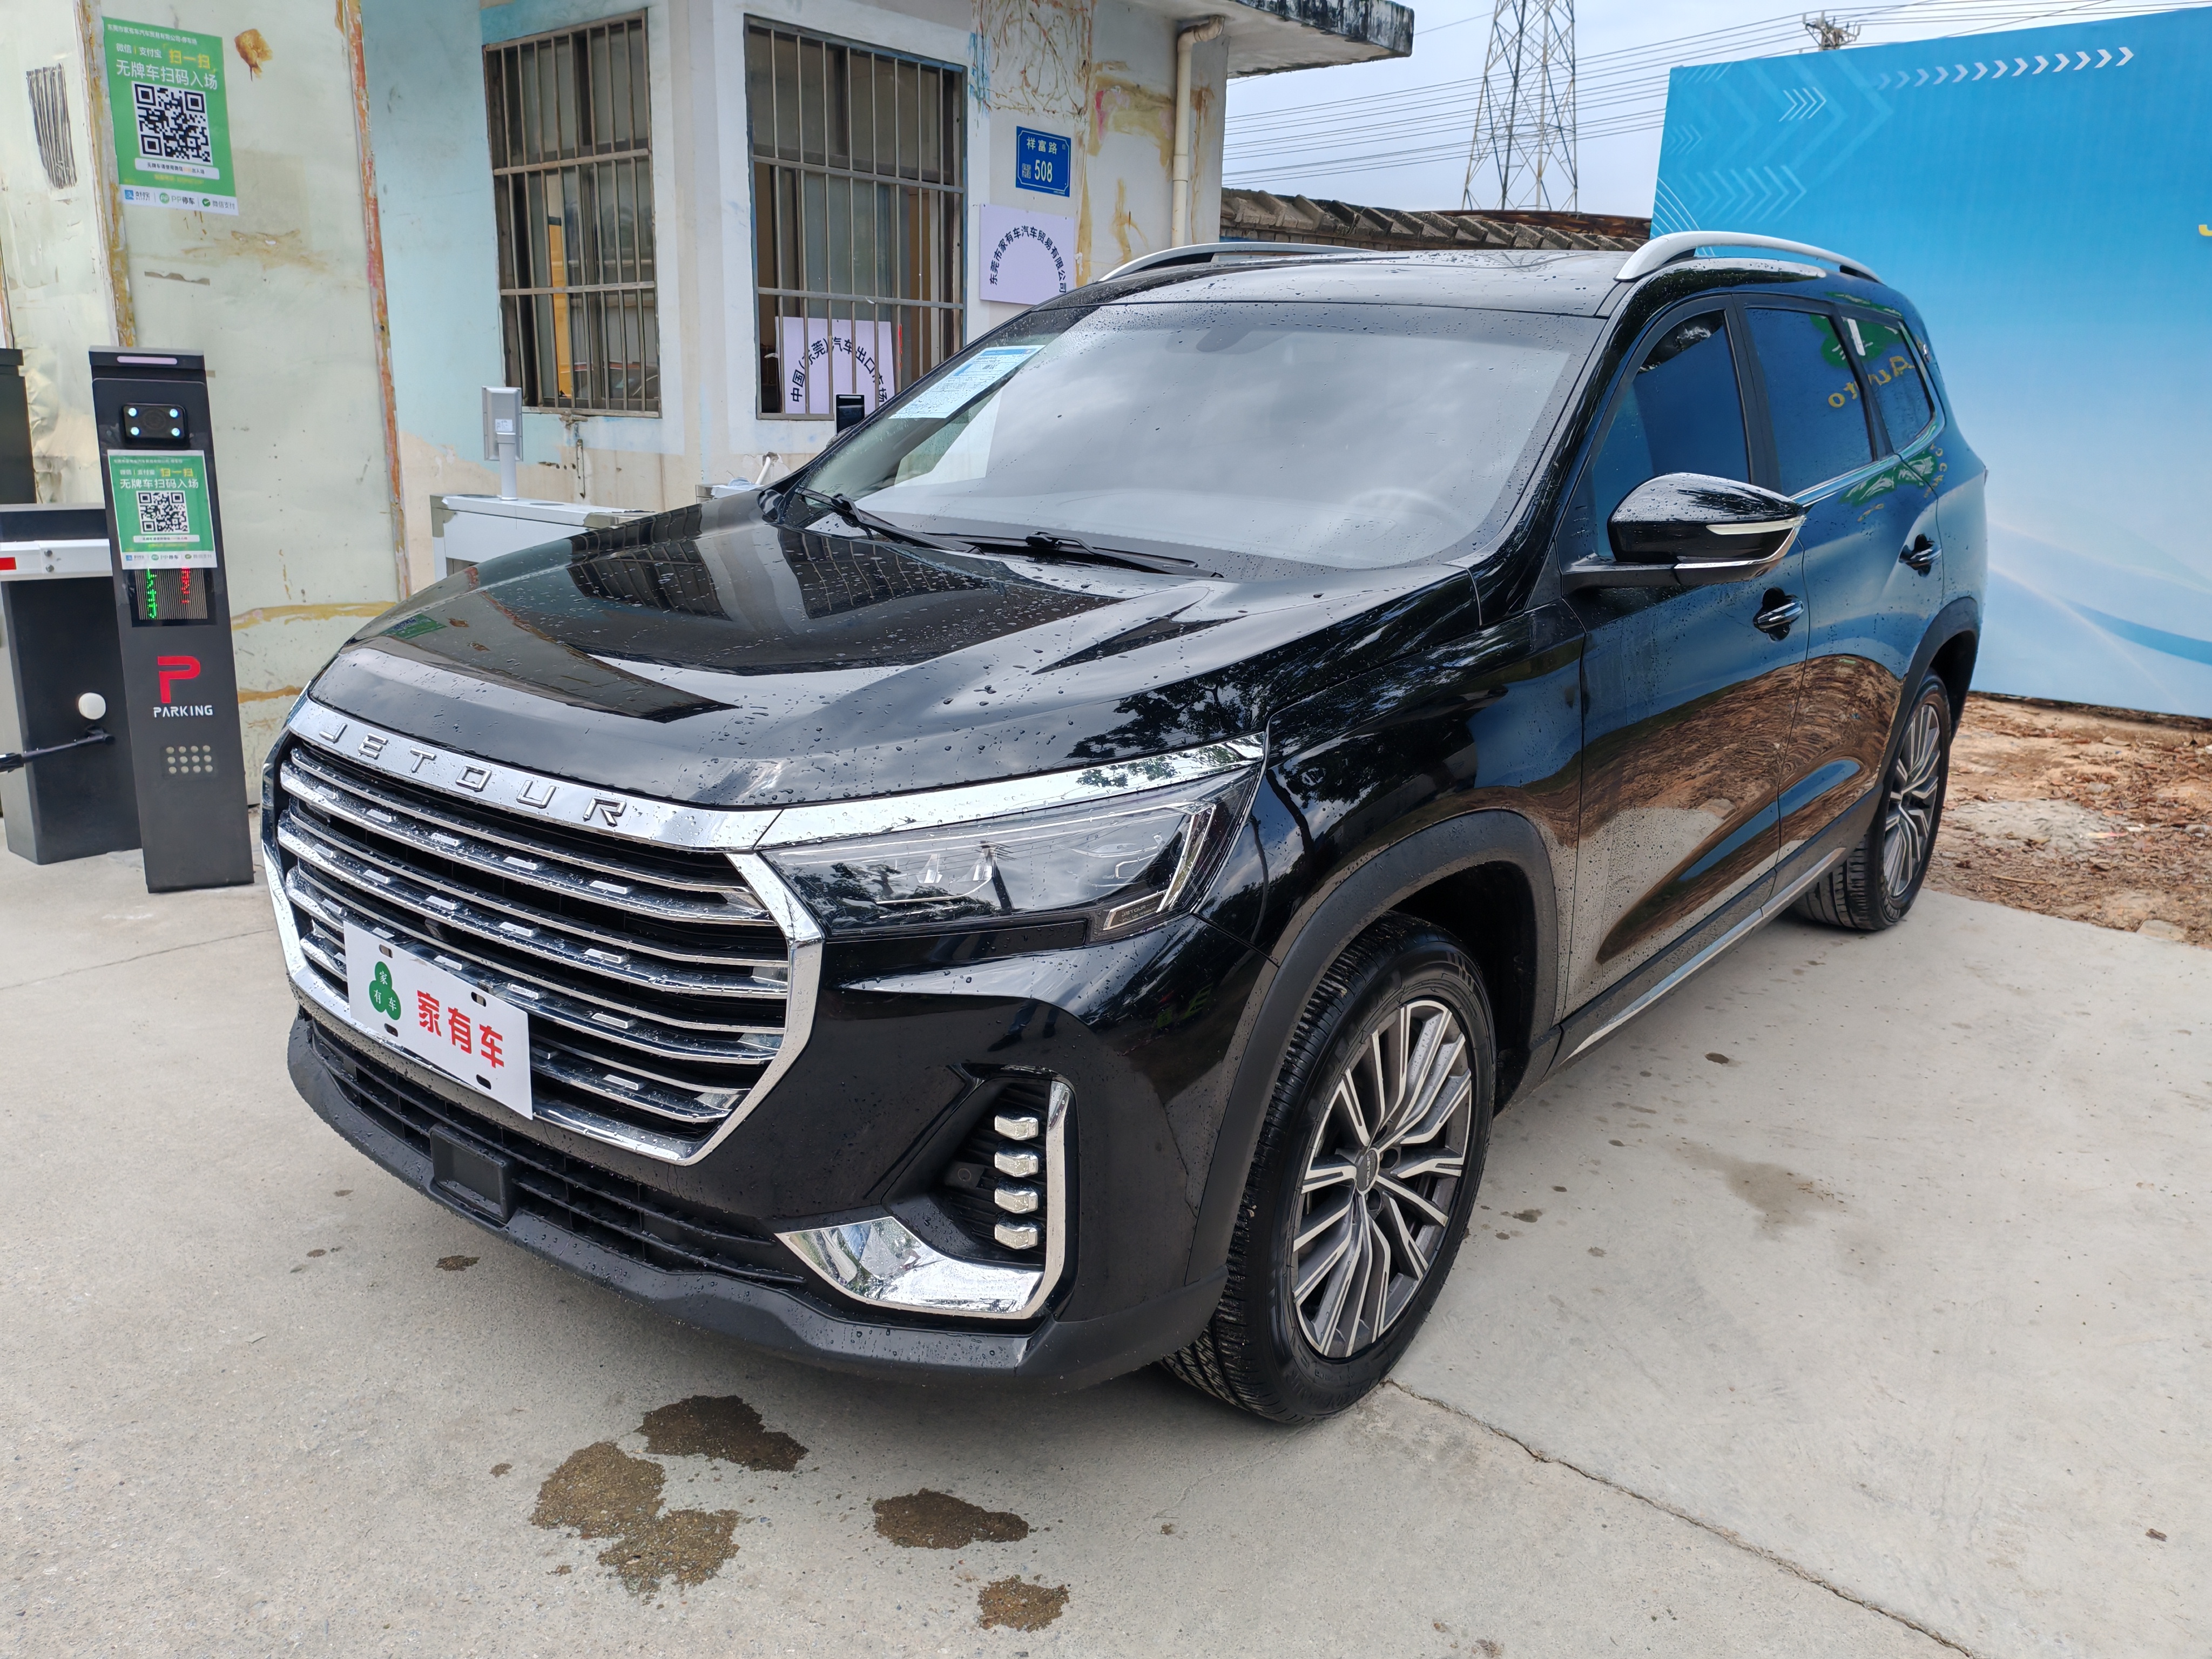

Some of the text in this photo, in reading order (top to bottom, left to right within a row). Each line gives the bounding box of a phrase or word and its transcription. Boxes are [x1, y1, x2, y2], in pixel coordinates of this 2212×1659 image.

[116, 59, 217, 90] 无牌车扫码入场
[1026, 136, 1057, 155] 祥富路
[1034, 159, 1053, 183] 508
[989, 225, 1067, 294] 东莞市家有车汽车贸易有限公司
[120, 478, 199, 489] 无牌车扫码入场
[158, 656, 201, 704] P
[153, 705, 213, 718] PARKING
[319, 723, 627, 827] JETOUR
[1121, 905, 1147, 917] JETOUR
[417, 989, 504, 1069] 家有车
